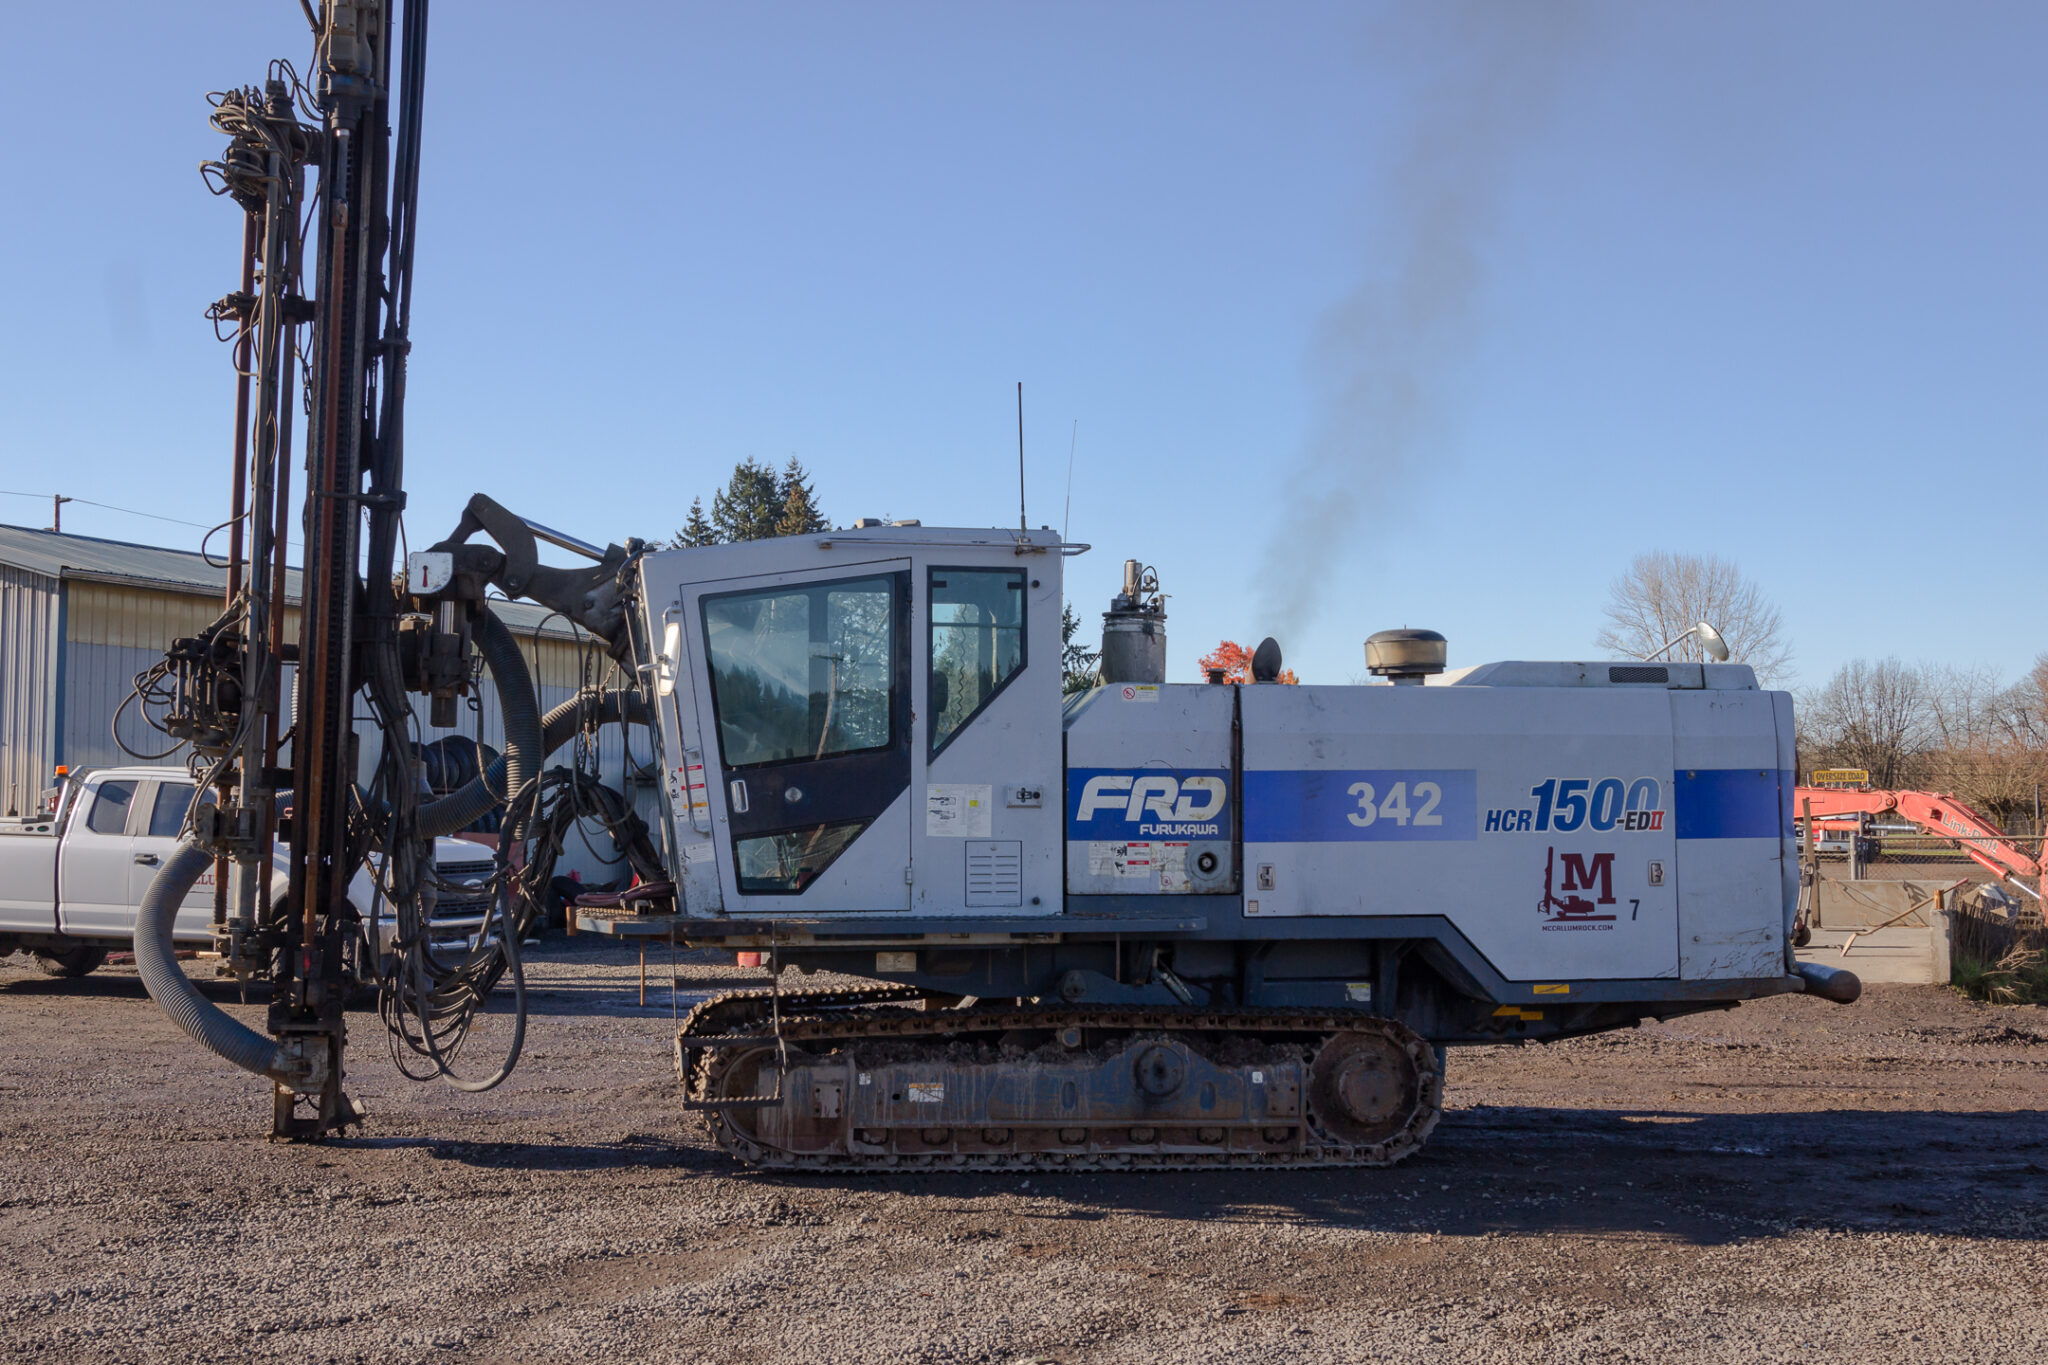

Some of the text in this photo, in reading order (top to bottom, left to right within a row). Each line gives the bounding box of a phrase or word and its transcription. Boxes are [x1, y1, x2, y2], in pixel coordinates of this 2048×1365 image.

[1815, 772, 1865, 781] OVERSIZE LOAD
[1076, 775, 1227, 821] FRD
[1346, 781, 1443, 827] 342
[1139, 823, 1219, 836] FURUKAWA
[1629, 899, 1641, 921] 7
[1541, 924, 1615, 932] MCCALLUMROCK.COM
